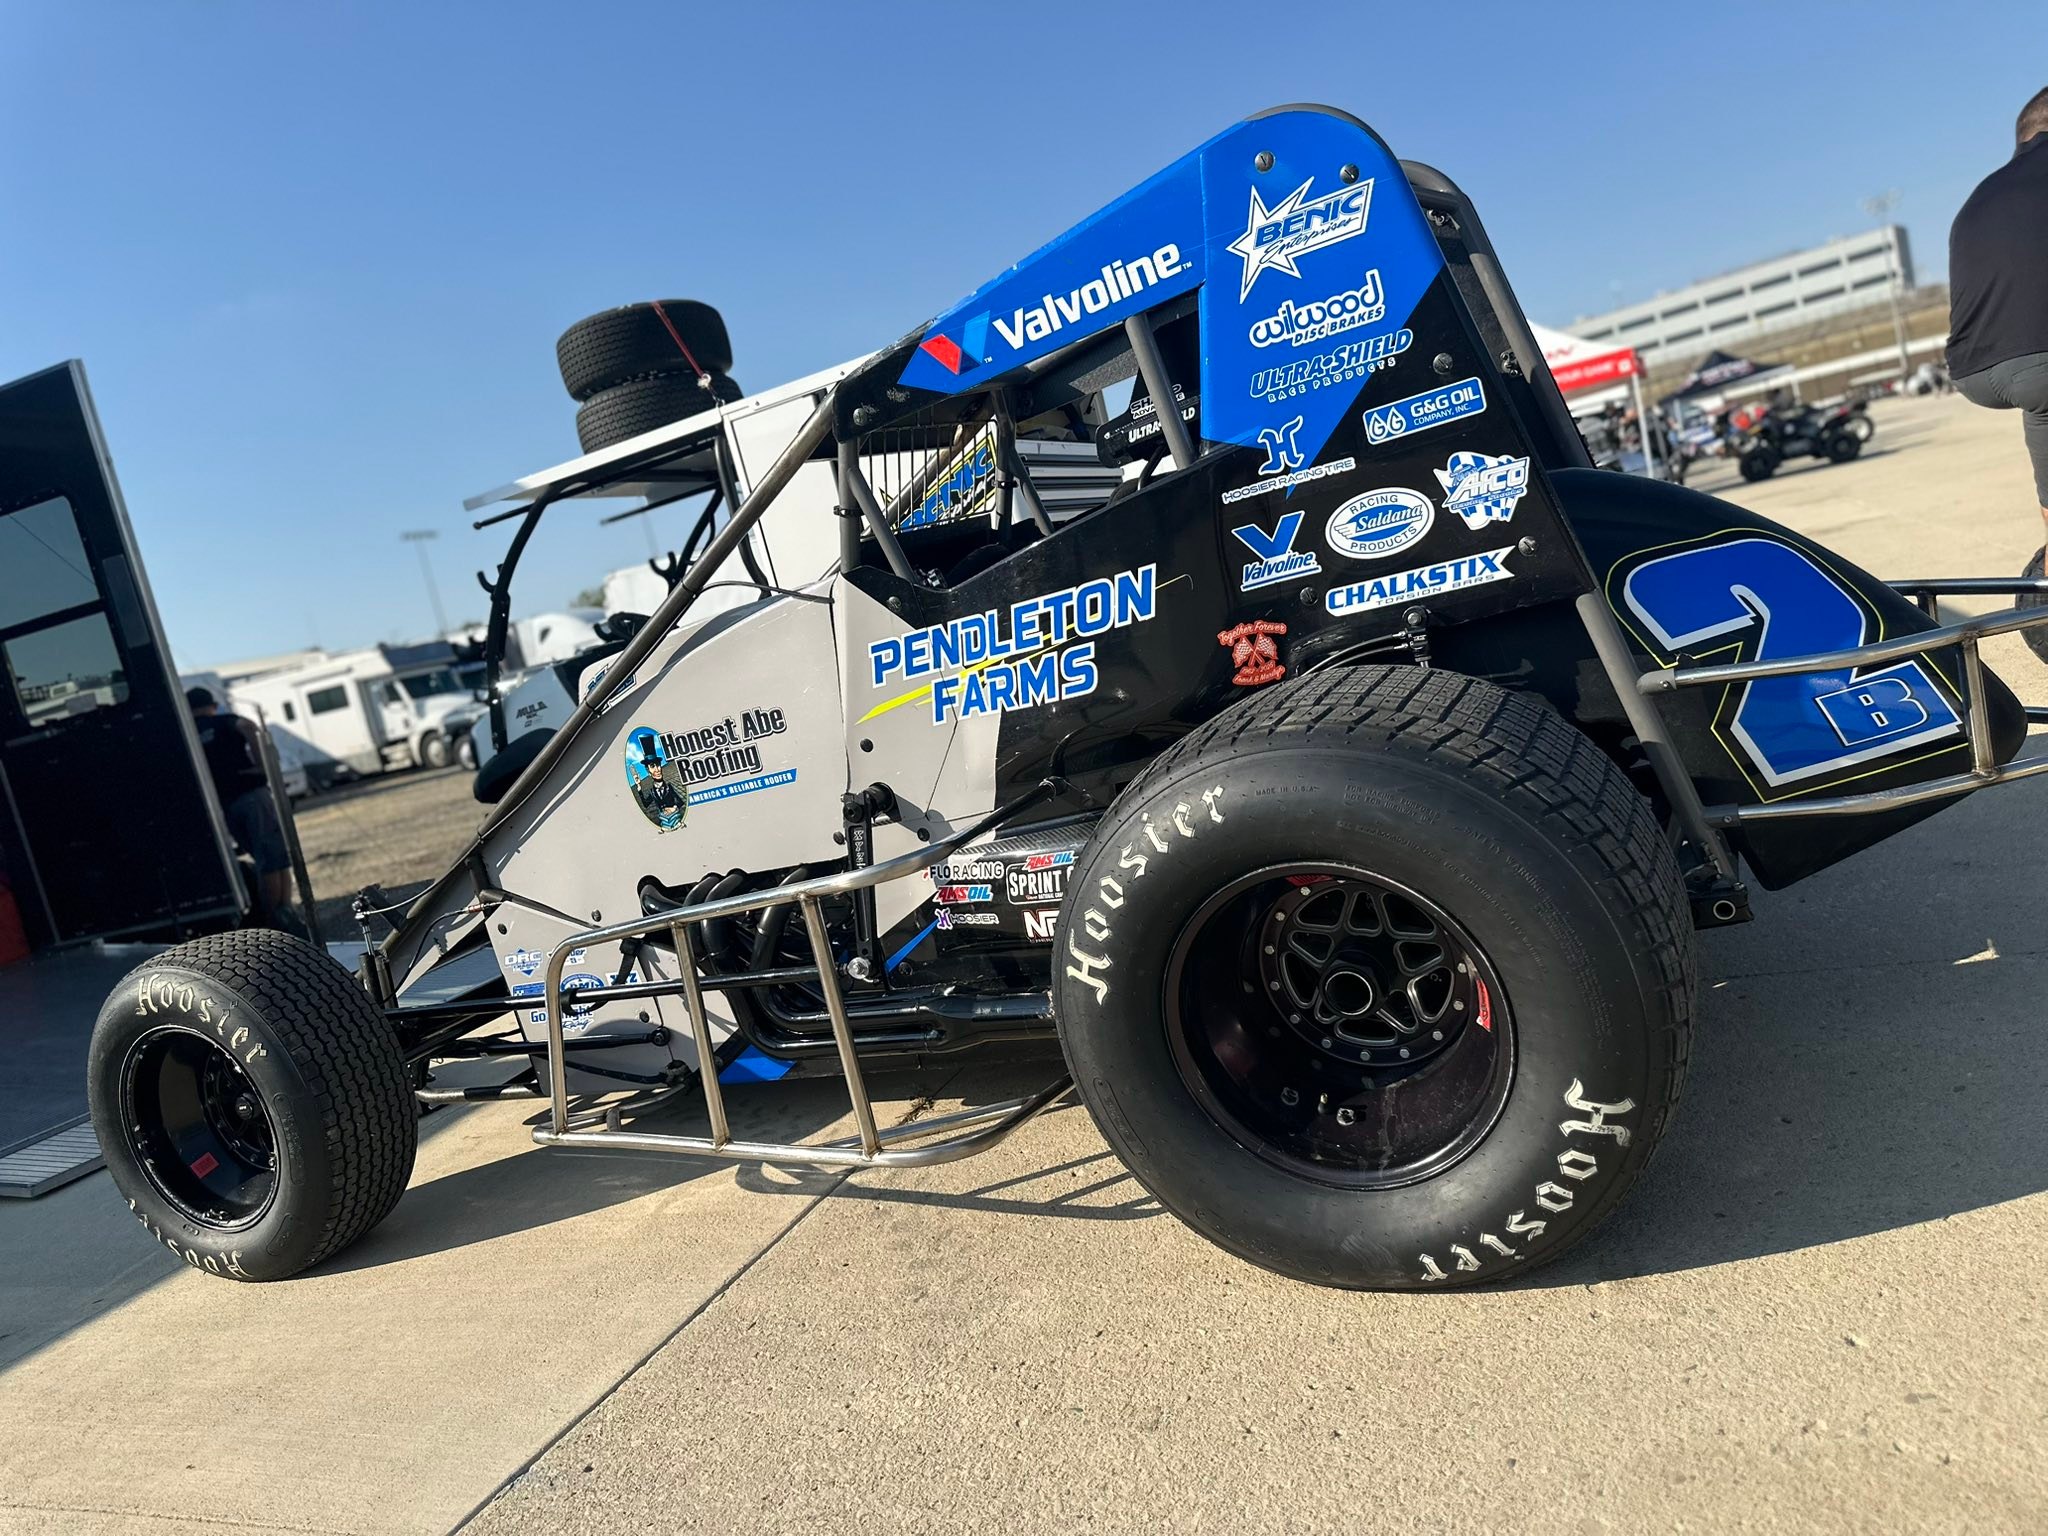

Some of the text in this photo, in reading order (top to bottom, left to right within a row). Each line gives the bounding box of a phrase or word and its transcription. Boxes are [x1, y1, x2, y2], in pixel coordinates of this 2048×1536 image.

[1253, 189, 1365, 249] BENIC
[1259, 216, 1360, 264] Enterprises
[992, 243, 1183, 350] Valvoline
[1252, 271, 1382, 345] wilwood
[1294, 306, 1383, 345] DISC BRAKES
[1268, 357, 1396, 402] RACE PRODUCTS
[1410, 386, 1480, 418] G&G OIL
[1223, 459, 1353, 501] HOOSIER RACING TIRE
[1349, 494, 1398, 514] RACING
[1356, 505, 1422, 531] Saldana
[1351, 526, 1417, 551] PRODUCTS
[1243, 552, 1317, 583] Valvoline
[1328, 552, 1501, 611] CHALKSTIX
[1376, 575, 1495, 605] TORSION BARS
[868, 563, 1157, 688] PENDLETON
[933, 643, 1098, 726] FARMS
[659, 707, 787, 761] Honest Abe
[675, 744, 762, 785] Roofing
[689, 772, 793, 804] AMERICA'S RELIABLE ROOFER
[1025, 853, 1073, 869] AMSOIL
[936, 886, 991, 902] AMSOIL
[1009, 870, 1062, 896] SPRINT
[1067, 784, 1225, 1005] Hoosier
[951, 914, 999, 924] HOOSIER
[136, 973, 267, 1063] Hoosier
[1420, 1078, 1636, 1282] Hoosier
